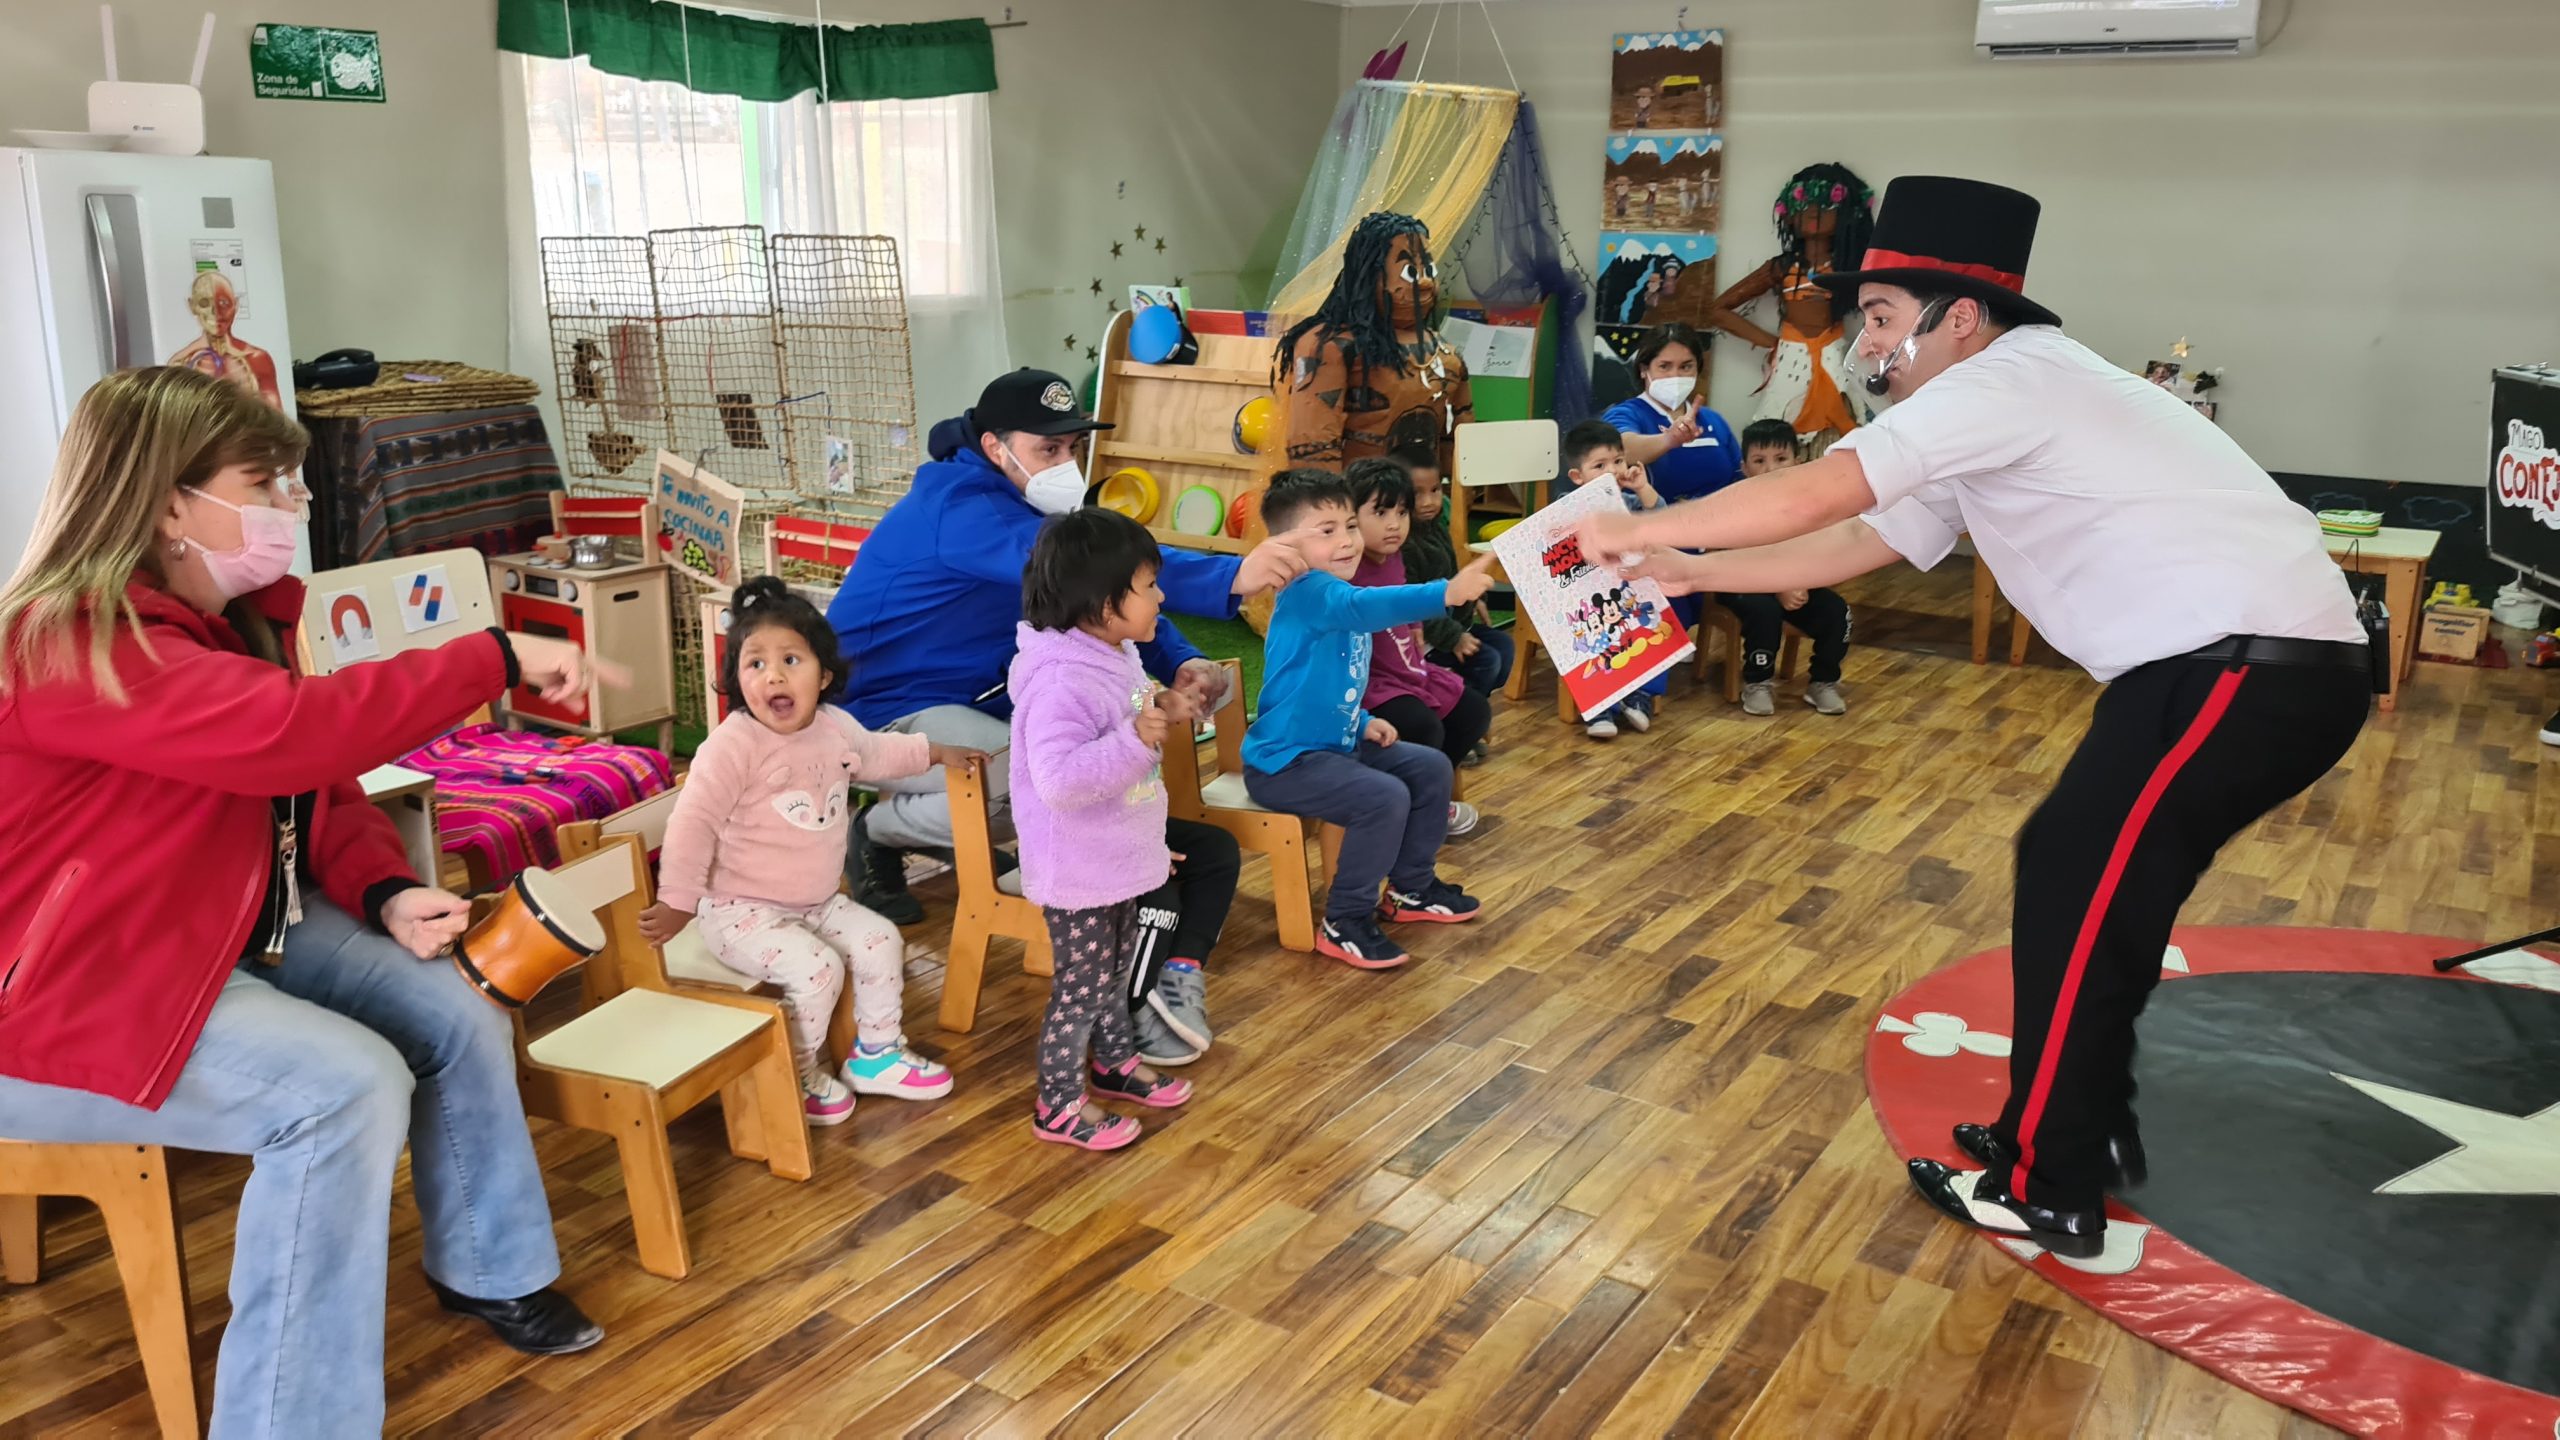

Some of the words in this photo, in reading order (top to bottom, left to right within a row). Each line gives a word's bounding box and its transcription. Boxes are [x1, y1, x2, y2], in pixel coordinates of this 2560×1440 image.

[256, 72, 283, 84] Zona
[285, 74, 299, 85] de
[258, 84, 310, 97] Seguridad
[716, 509, 730, 528] A
[1542, 533, 1581, 566] MICK
[1550, 549, 1584, 578] MOU
